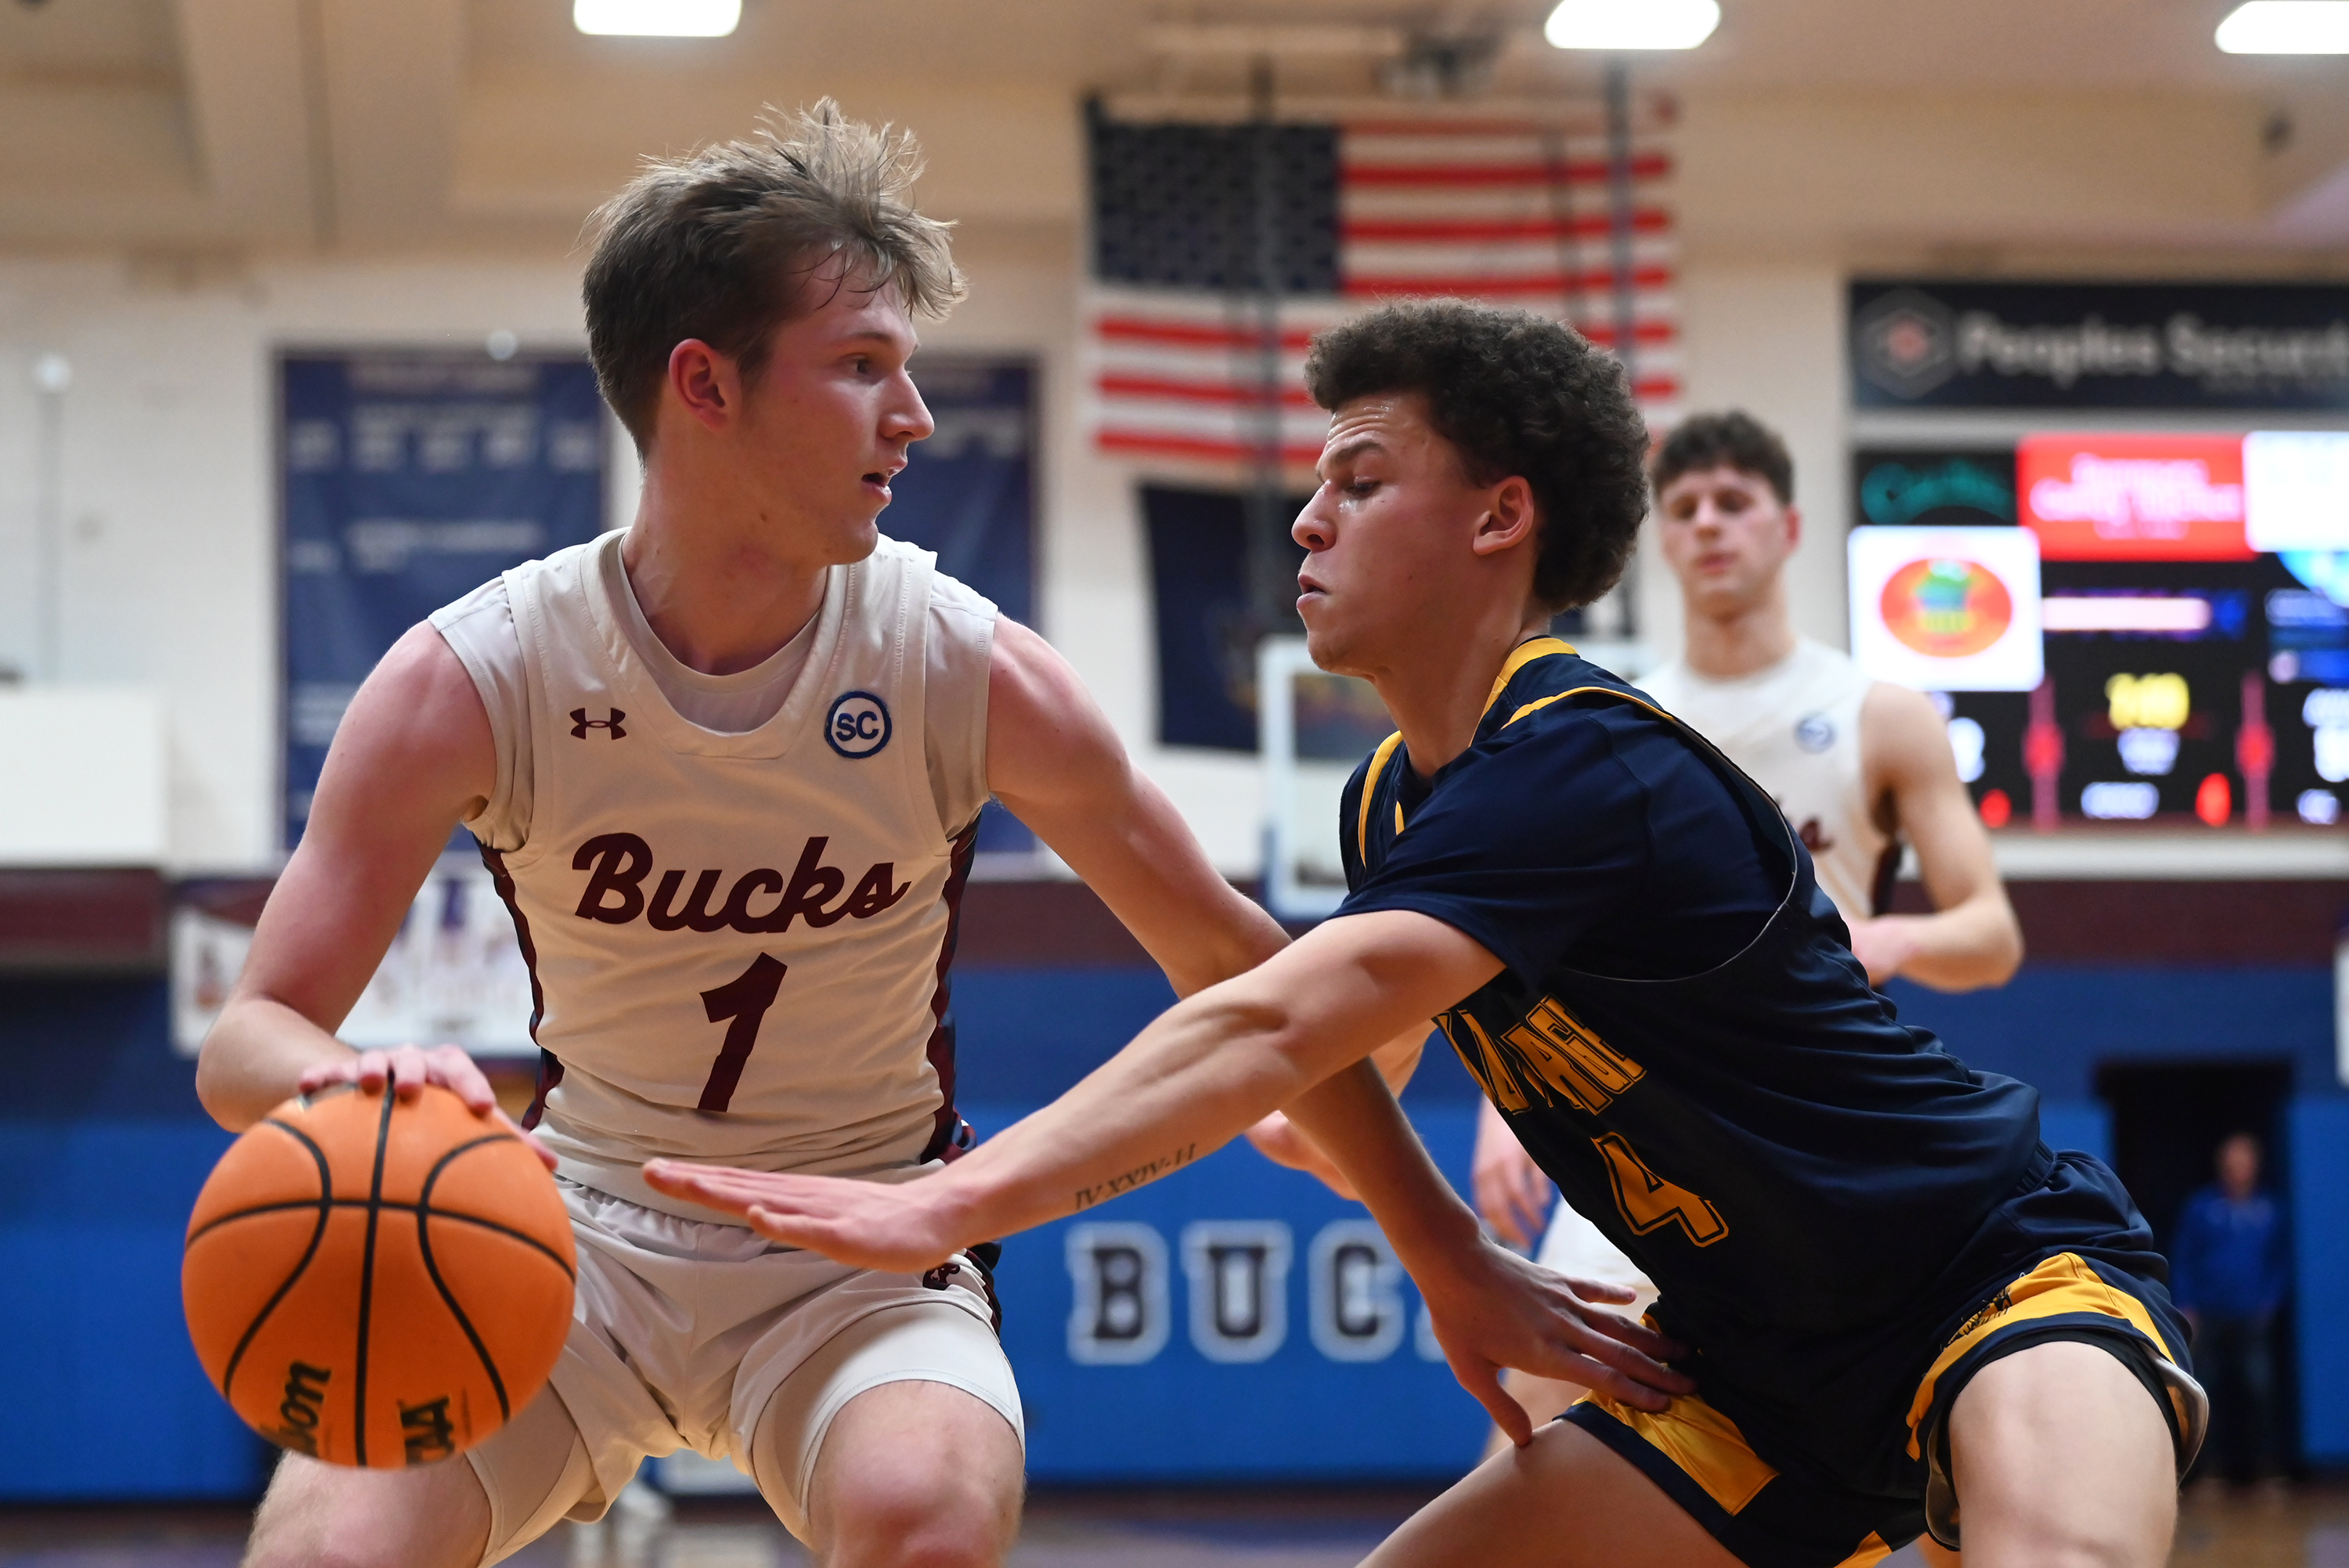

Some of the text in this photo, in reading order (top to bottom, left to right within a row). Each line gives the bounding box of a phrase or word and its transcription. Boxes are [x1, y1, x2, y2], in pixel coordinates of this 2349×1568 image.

[2167, 313, 2349, 376] Securit
[835, 710, 879, 743] SC
[572, 832, 912, 934] Bucks
[696, 951, 788, 1113] 1
[1589, 1131, 1729, 1248] 4
[1065, 1218, 1453, 1365] BUC
